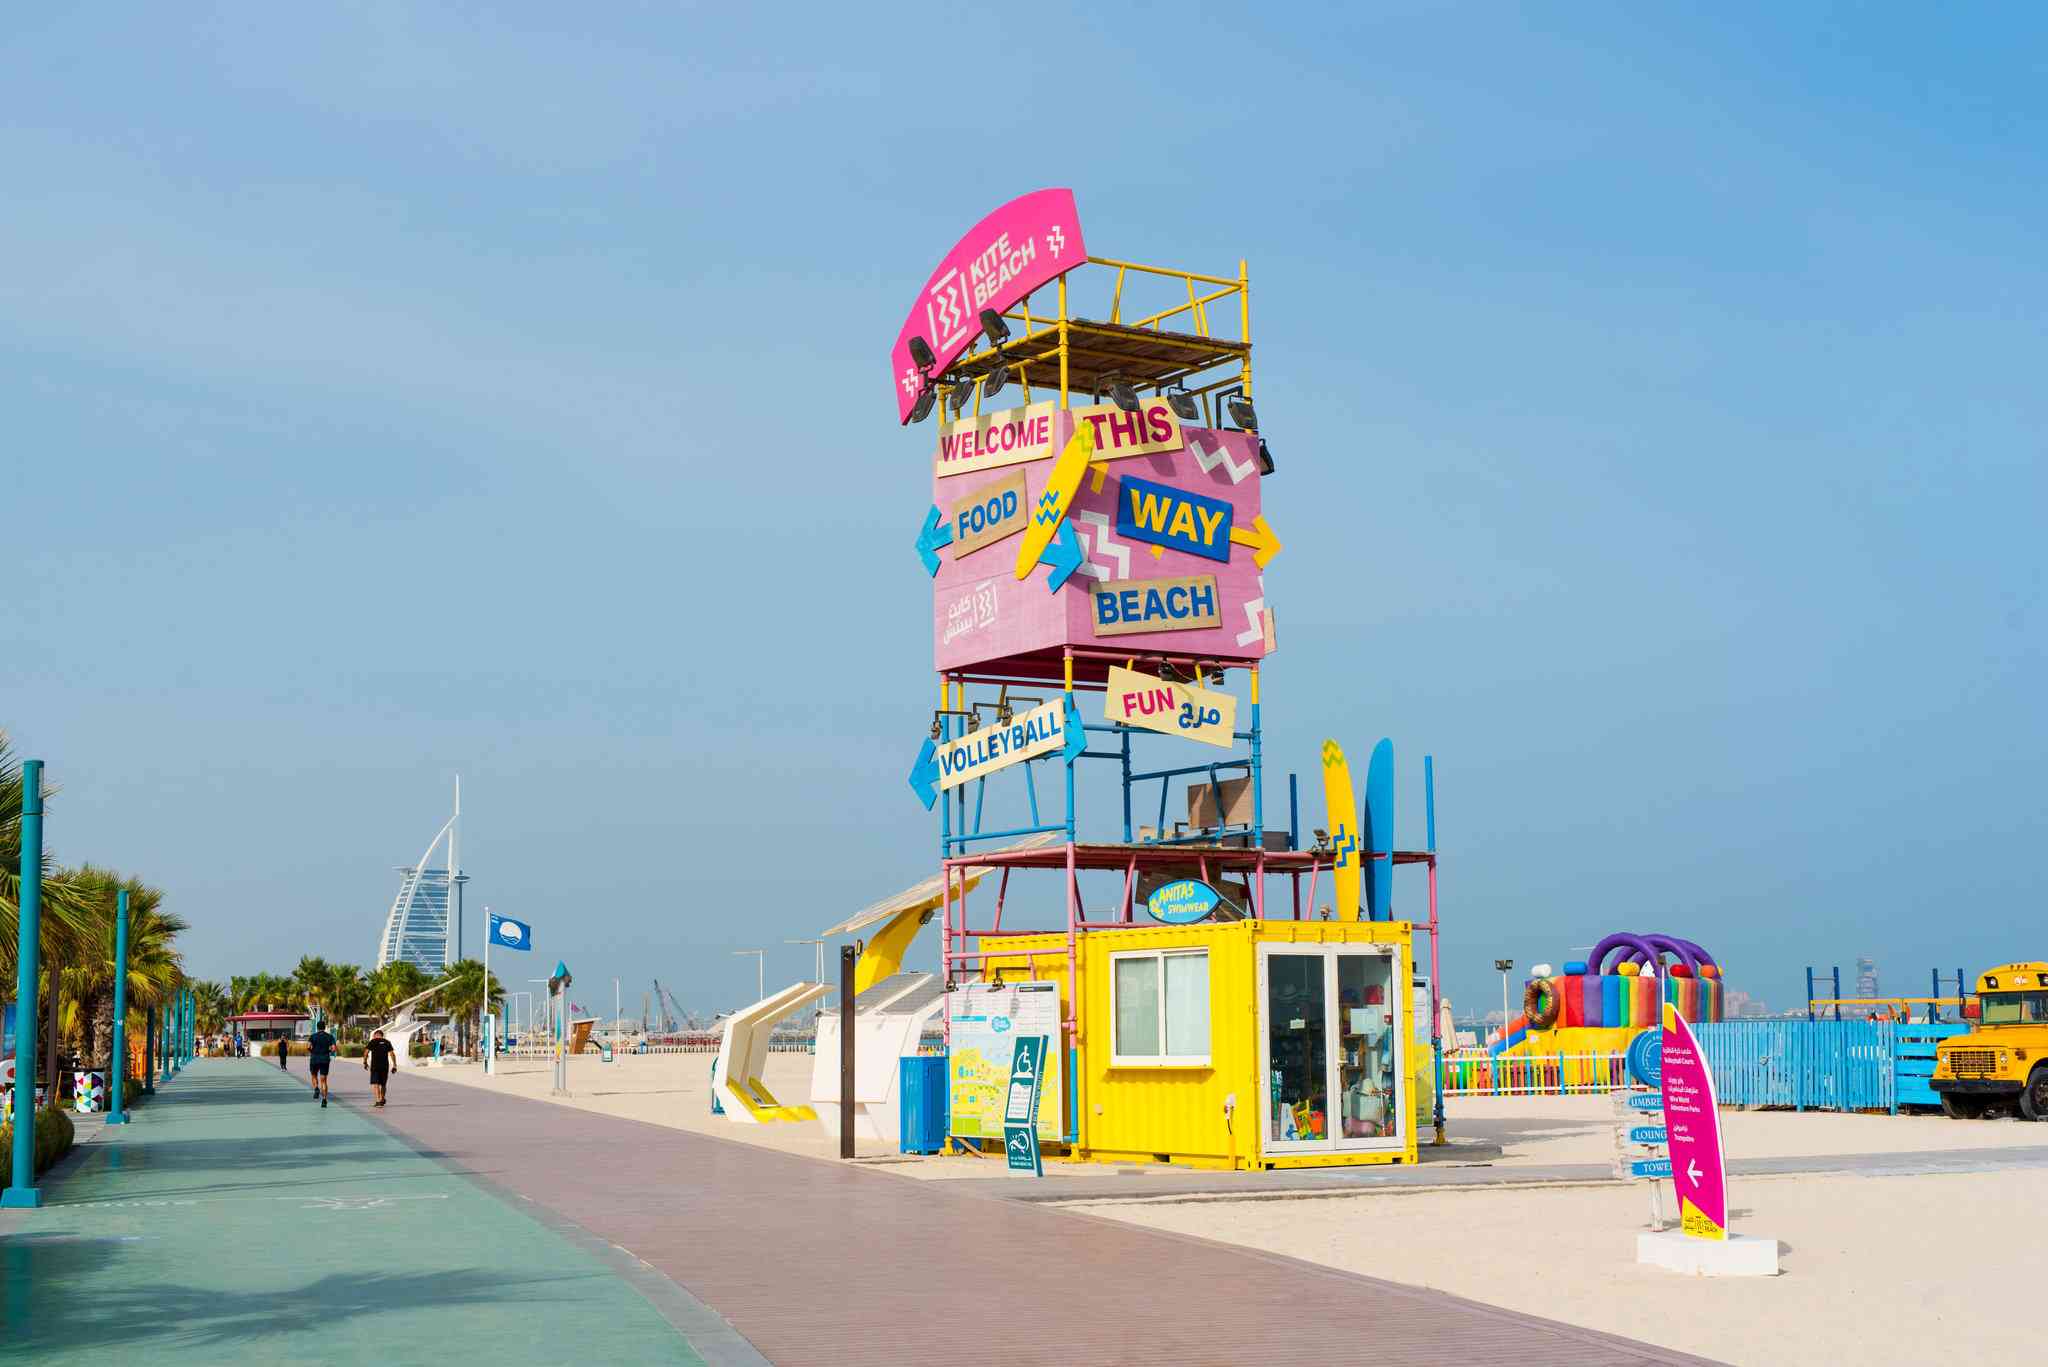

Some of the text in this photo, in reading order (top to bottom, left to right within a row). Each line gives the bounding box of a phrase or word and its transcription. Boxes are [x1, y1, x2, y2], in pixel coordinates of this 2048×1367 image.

[970, 231, 1012, 285] KITE
[974, 236, 1036, 309] BEACH
[941, 415, 1049, 463] WELCOME
[1083, 406, 1173, 450] THIS
[958, 490, 1017, 540] FOOD
[1131, 489, 1224, 546] WAY
[1096, 585, 1214, 625] BEACH
[1122, 687, 1221, 729] FUN مرح
[940, 711, 1062, 777] VOLLEYBALL
[1159, 882, 1194, 904] ANITAS
[1168, 902, 1209, 913] SWIMWEAR
